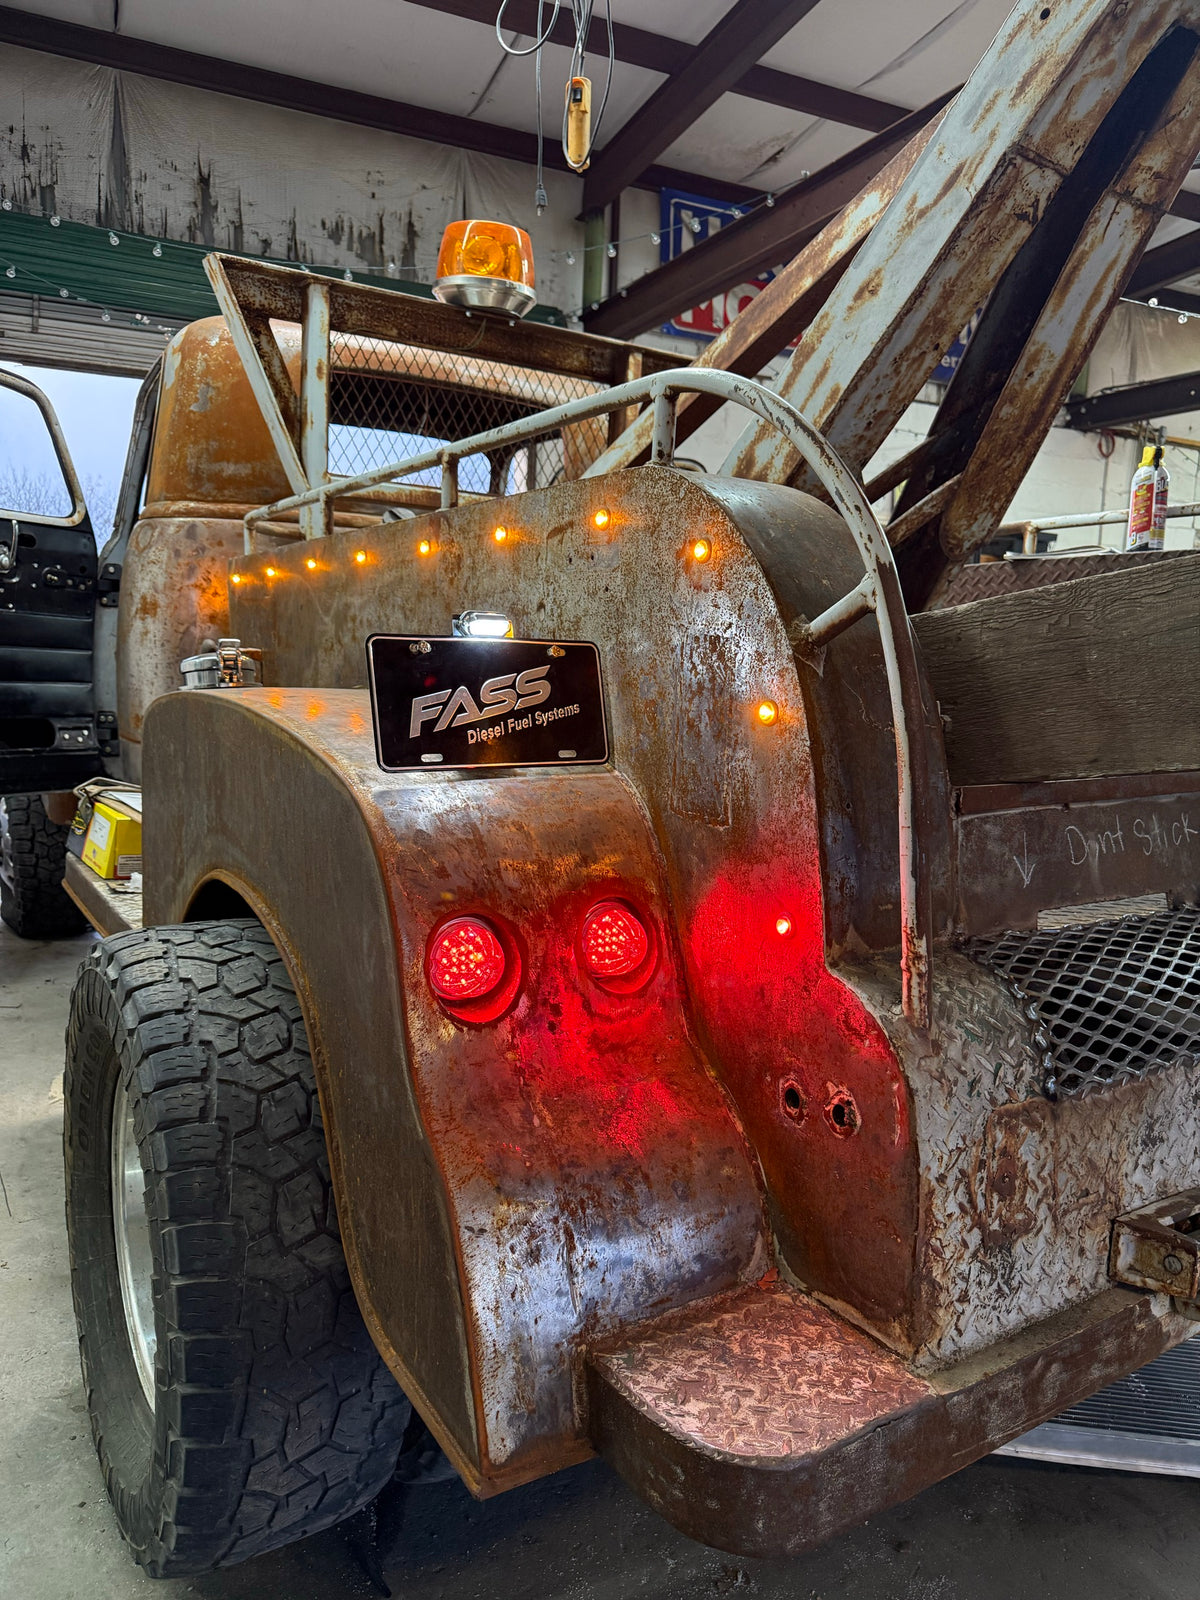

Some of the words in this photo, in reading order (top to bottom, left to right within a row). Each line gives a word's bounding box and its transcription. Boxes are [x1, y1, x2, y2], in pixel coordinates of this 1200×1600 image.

[409, 664, 552, 739] FASS
[467, 721, 506, 745] Diesel
[507, 712, 533, 733] Fuel
[535, 702, 581, 726] Systems
[1132, 812, 1199, 856] Stick
